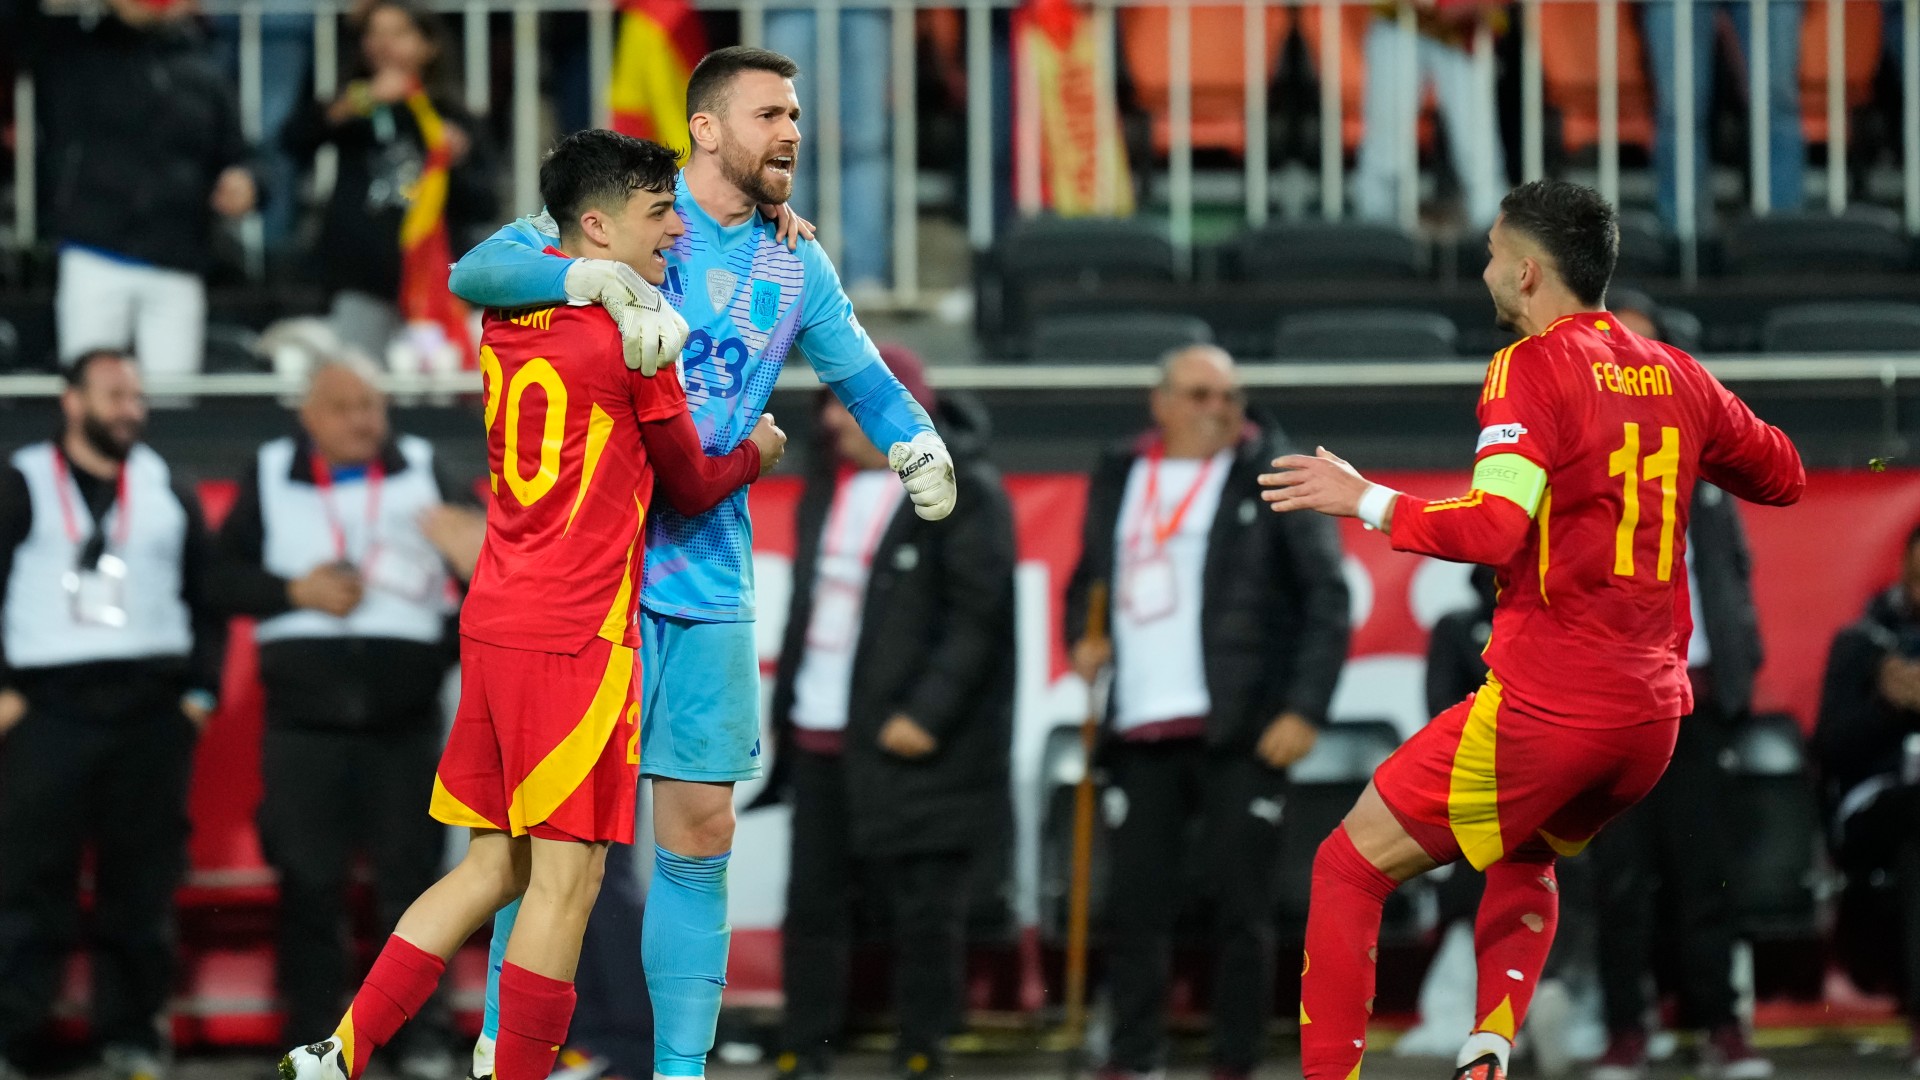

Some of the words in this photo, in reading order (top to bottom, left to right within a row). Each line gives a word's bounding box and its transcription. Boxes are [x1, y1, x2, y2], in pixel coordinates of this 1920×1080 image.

[683, 328, 749, 399] 23
[1592, 361, 1673, 396] FERRAN
[479, 344, 568, 507] 20
[898, 452, 934, 480] eusch
[1608, 422, 1680, 582] 11
